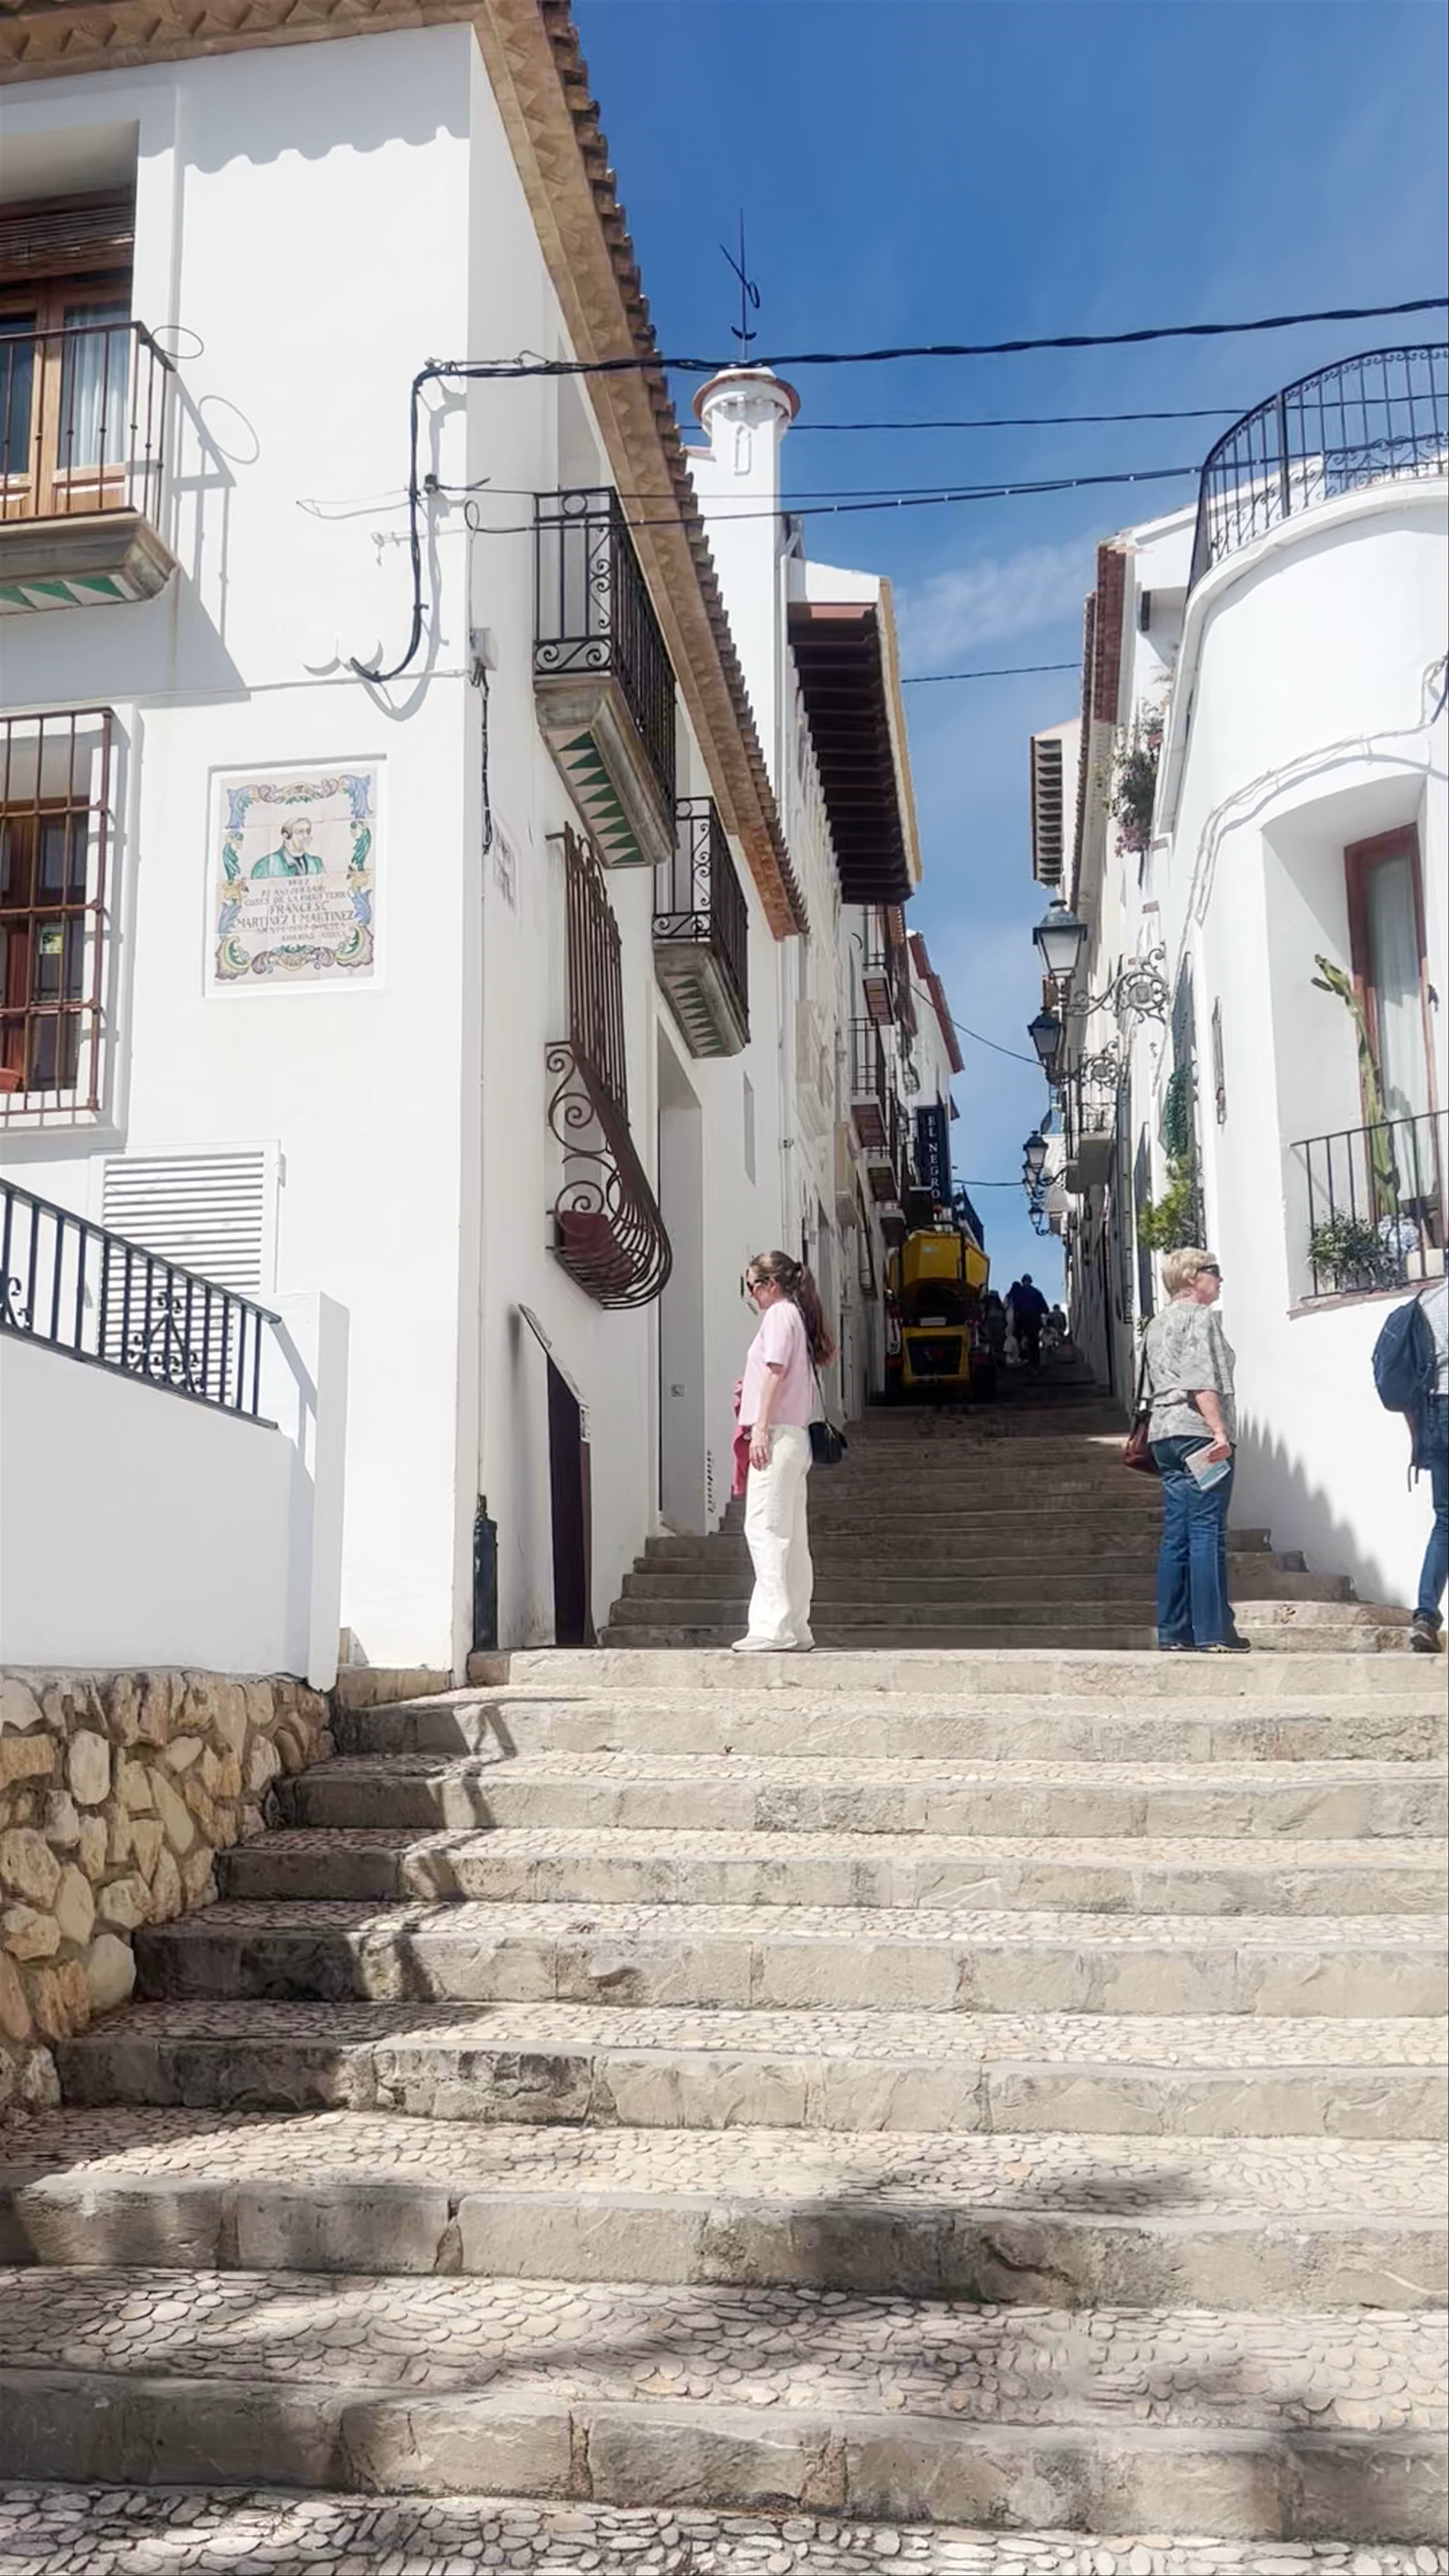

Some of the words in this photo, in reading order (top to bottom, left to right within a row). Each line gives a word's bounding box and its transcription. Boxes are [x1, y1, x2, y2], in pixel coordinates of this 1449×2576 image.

[270, 901, 329, 915] FRANCESC
[928, 1115, 937, 1137] EL
[929, 1143, 941, 1199] NEGRO
